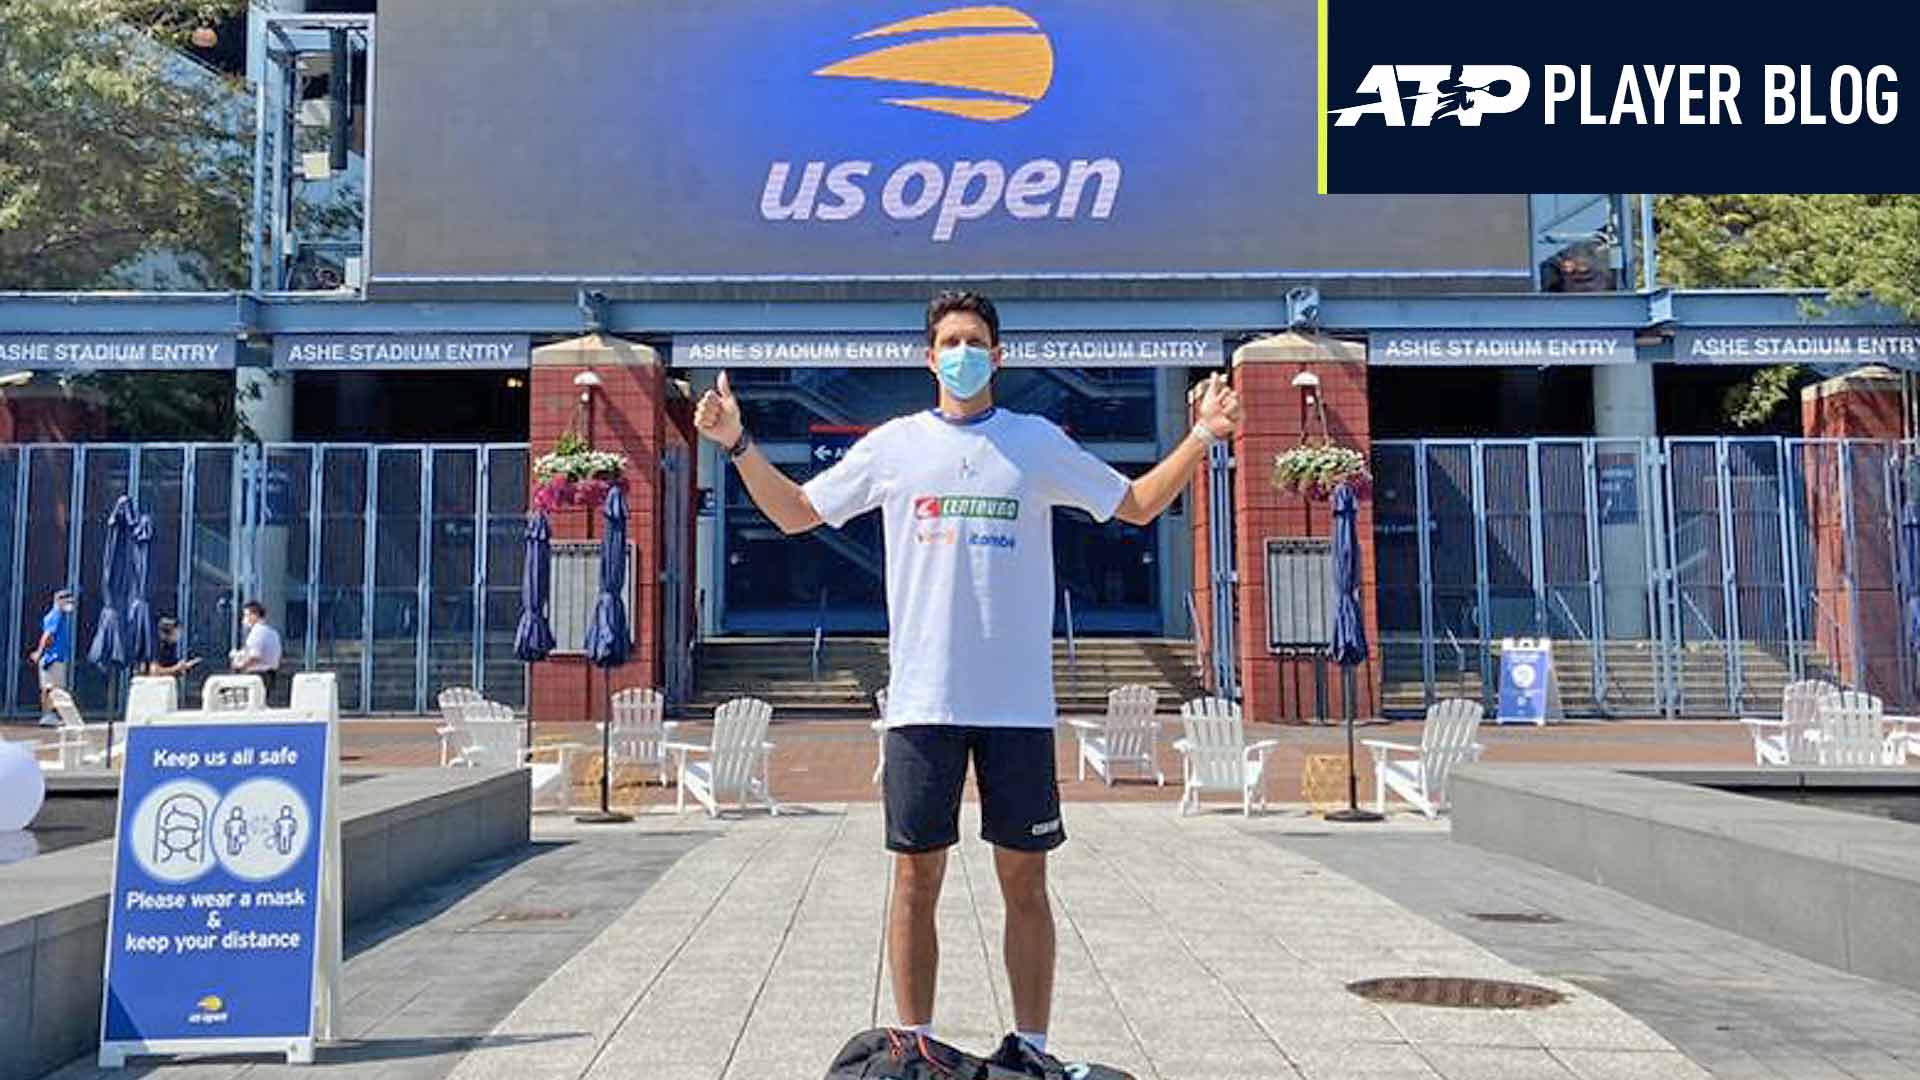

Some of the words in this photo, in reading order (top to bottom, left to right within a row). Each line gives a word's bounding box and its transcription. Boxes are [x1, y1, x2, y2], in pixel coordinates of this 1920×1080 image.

[760, 160, 872, 221] us
[881, 158, 1121, 241] open
[54, 343, 145, 361] STADIUM
[151, 343, 219, 361] ENTRY
[287, 343, 346, 362] ASHE
[349, 343, 440, 362] STADIUM
[445, 343, 514, 361] ENTRY
[688, 343, 745, 361] ASHE
[748, 343, 839, 361] STADIUM
[846, 343, 913, 361] ENTRY
[999, 341, 1038, 359] SHE
[1043, 341, 1133, 359] STADIUM
[1139, 340, 1208, 359] ENTRY
[1385, 339, 1443, 357] ASHE
[1447, 339, 1541, 357] STADIUM
[1548, 339, 1617, 357] ENTRY
[1691, 338, 1750, 356] ASHE
[1754, 338, 1851, 355] STADIUM
[153, 748, 200, 770] Keep
[204, 752, 227, 767] us
[231, 748, 252, 766] all
[259, 746, 299, 766] safe
[125, 891, 187, 910] Please
[190, 893, 235, 909] wear
[239, 893, 252, 908] a
[255, 888, 306, 907] mask
[206, 911, 222, 930] &
[125, 932, 170, 953] keep
[175, 935, 217, 954] your
[221, 930, 301, 949] distance
